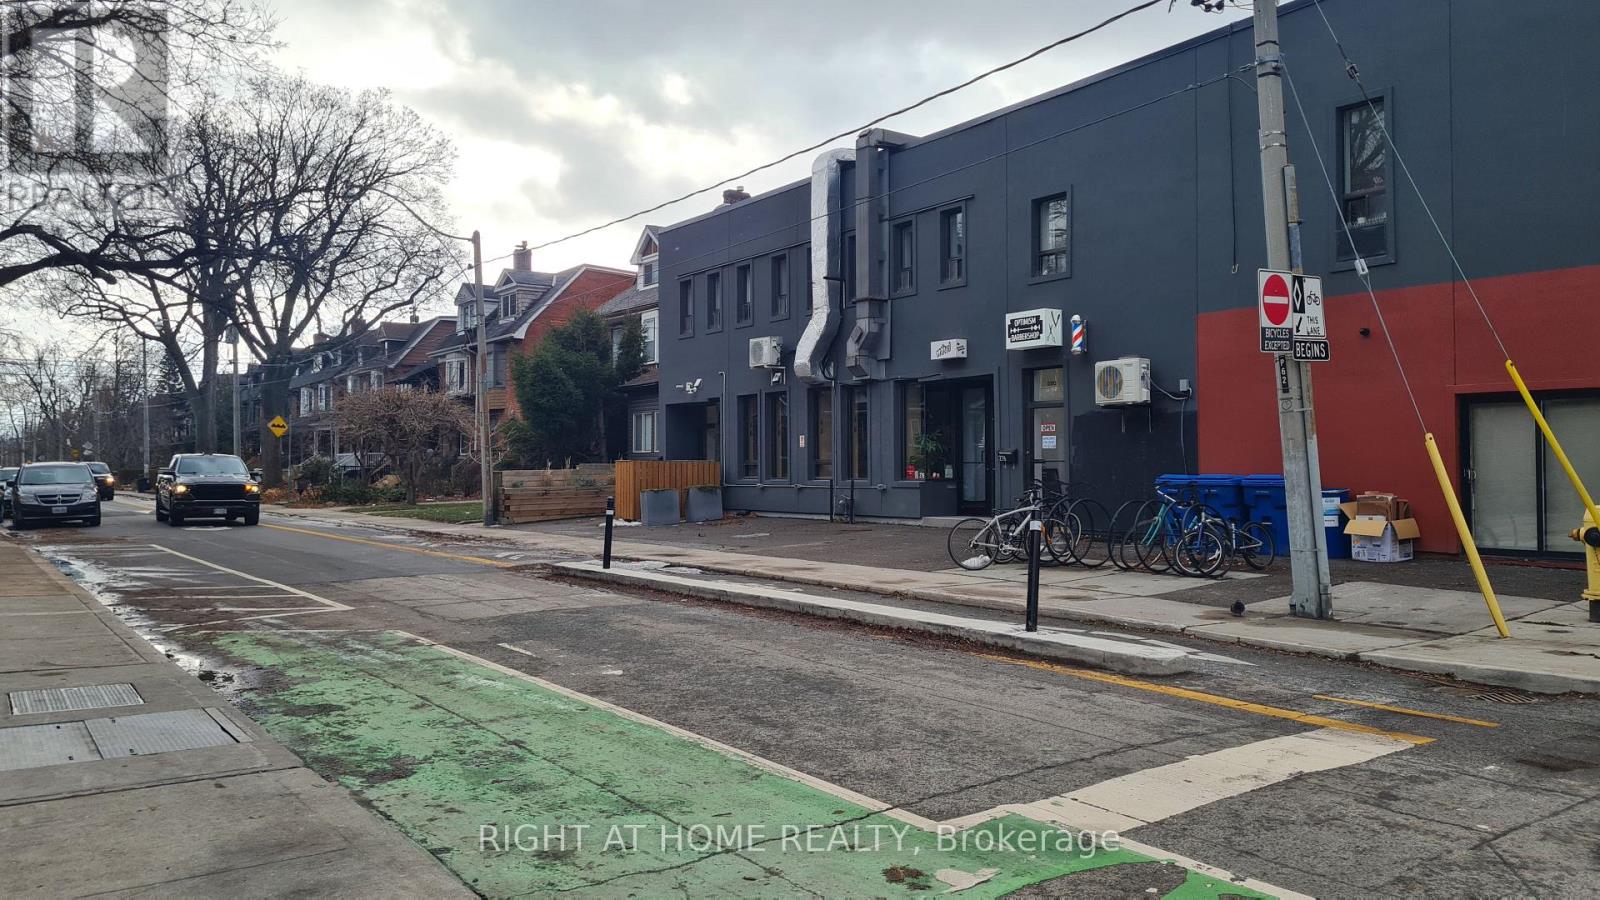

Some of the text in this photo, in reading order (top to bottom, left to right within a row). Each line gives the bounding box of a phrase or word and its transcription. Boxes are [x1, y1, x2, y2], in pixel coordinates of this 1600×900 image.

[1013, 317, 1037, 327] OPTIMISM
[1306, 315, 1319, 325] THIS
[1265, 328, 1290, 338] BICYCLES
[1306, 326, 1321, 336] LANE
[1010, 331, 1040, 342] BARBERSHOP
[1264, 341, 1290, 351] EXCEPTED
[1295, 342, 1326, 358] BEGINS
